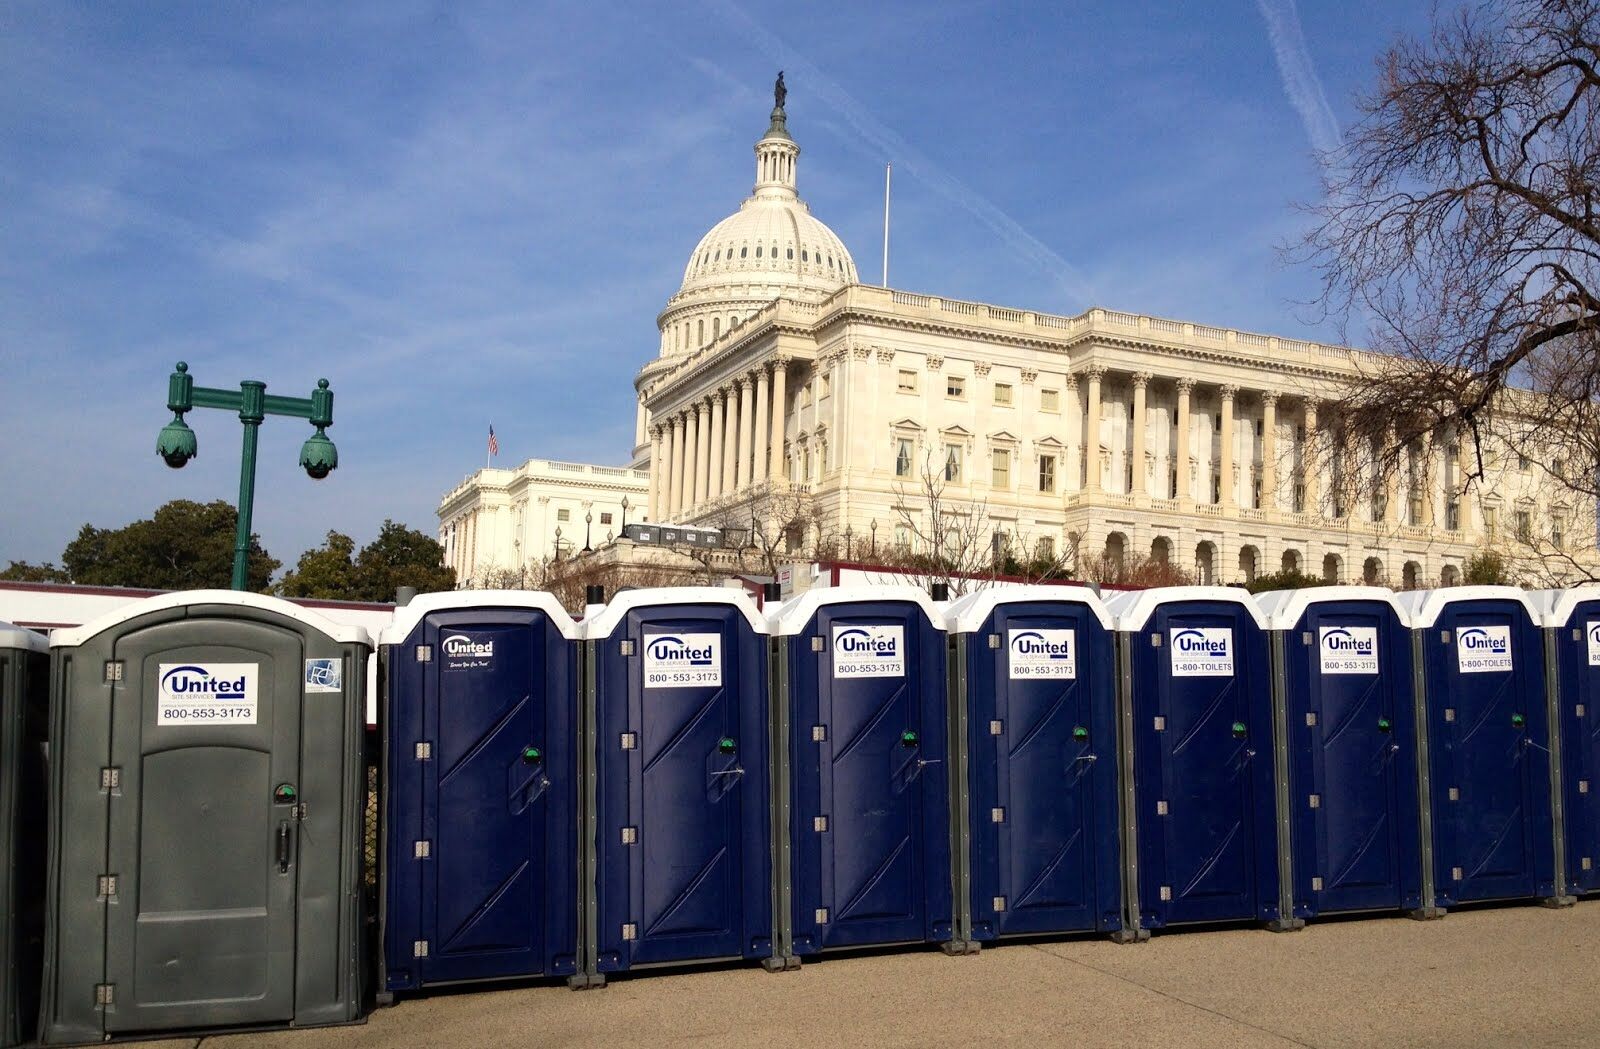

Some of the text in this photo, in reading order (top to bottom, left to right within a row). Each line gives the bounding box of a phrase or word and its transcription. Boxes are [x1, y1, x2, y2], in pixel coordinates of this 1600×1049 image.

[448, 641, 493, 653] United
[843, 637, 896, 652] United
[1018, 640, 1068, 653] United
[1180, 638, 1226, 651] United
[1328, 636, 1371, 650] United
[1466, 636, 1506, 649] United
[655, 645, 712, 660] United
[172, 676, 246, 692] United
